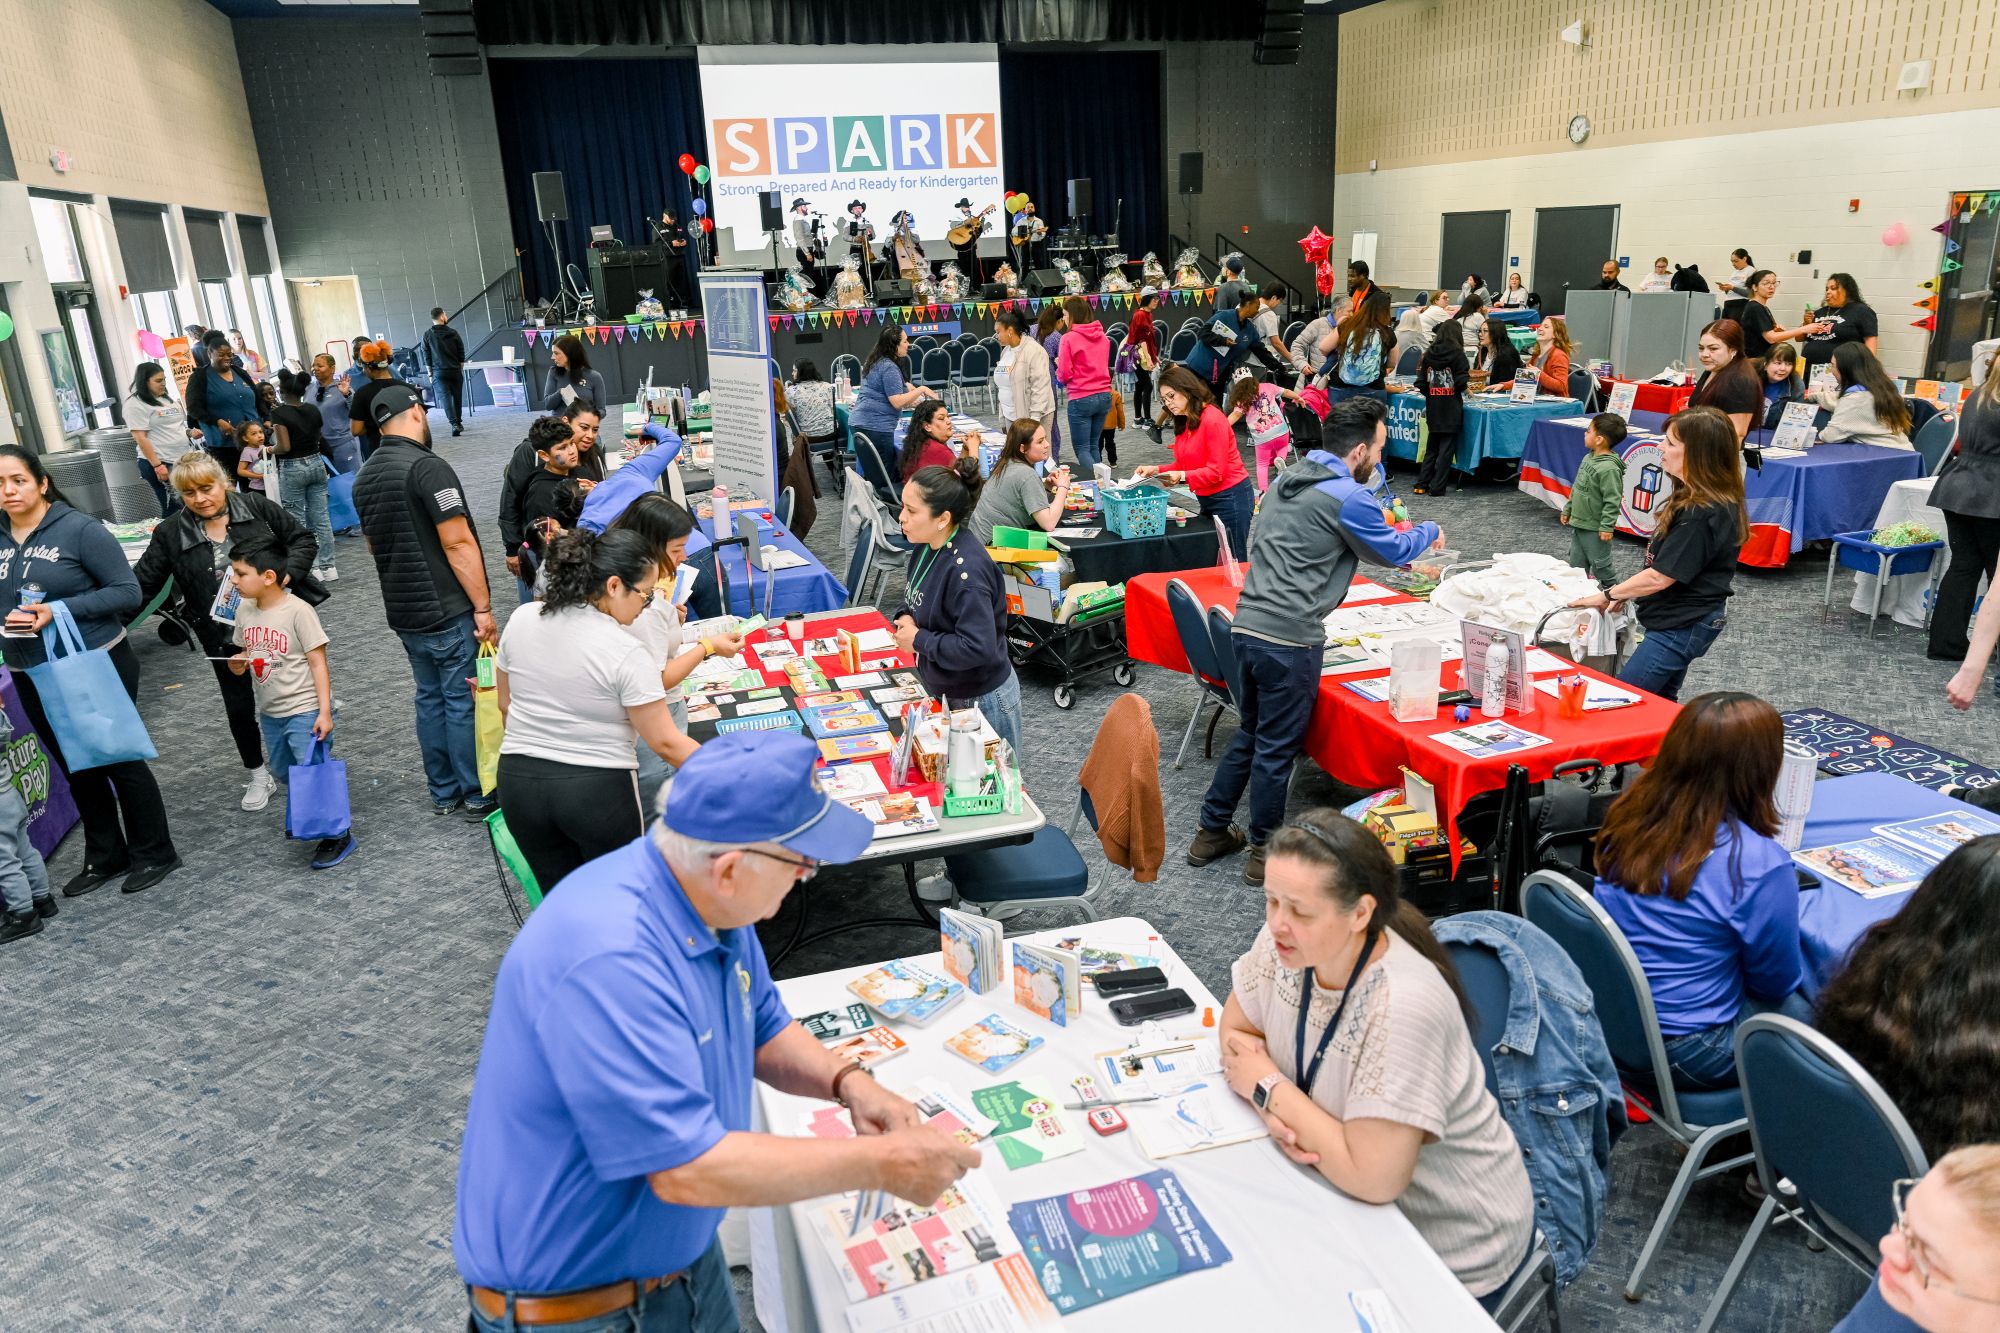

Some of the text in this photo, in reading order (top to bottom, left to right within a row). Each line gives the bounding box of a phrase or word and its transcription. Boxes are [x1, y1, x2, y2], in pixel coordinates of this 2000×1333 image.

[725, 117, 991, 172] SPARK
[769, 180, 827, 194] Prepared
[831, 178, 856, 191] And
[859, 177, 897, 192] Ready
[900, 176, 917, 188] for
[920, 175, 998, 189] Kindergarten
[1399, 400, 1426, 426] hop
[1388, 424, 1419, 442] nited
[244, 626, 288, 654] HICAGO
[20, 761, 46, 805] Play
[988, 1092, 1007, 1116] advice
[999, 1090, 1019, 1115] Poison
[1037, 1117, 1055, 1139] HELP
